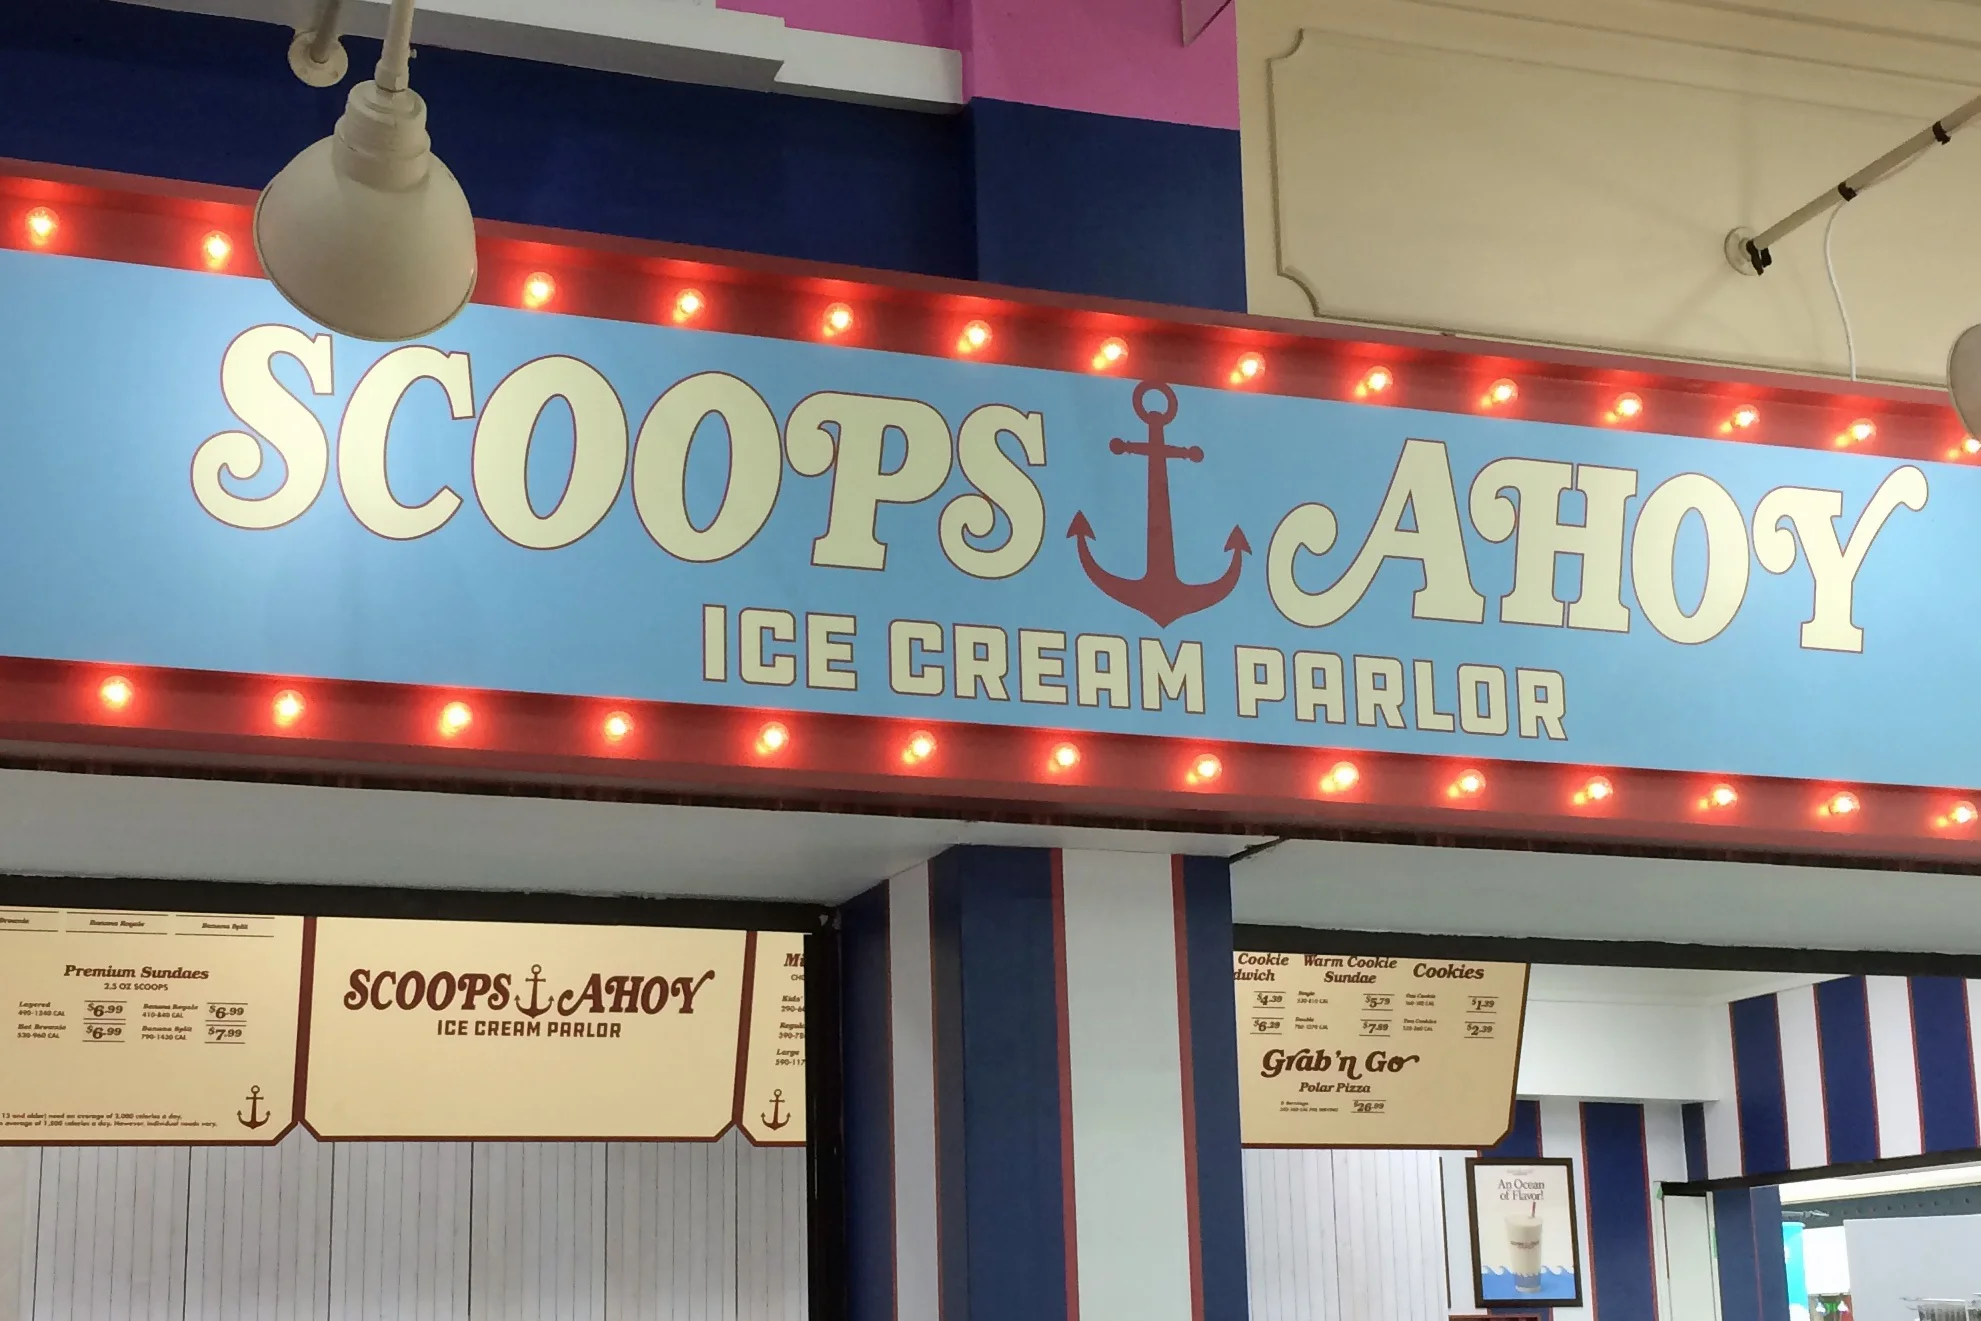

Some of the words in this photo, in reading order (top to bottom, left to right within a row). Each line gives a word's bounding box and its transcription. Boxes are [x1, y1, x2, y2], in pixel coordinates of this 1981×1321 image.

[191, 324, 1046, 580] SCOOPS
[1266, 437, 1929, 653] AHOY
[703, 604, 858, 691] ICE
[888, 618, 1207, 715] CREAM
[1235, 645, 1568, 741] PARLOR
[783, 952, 805, 967] Mi
[1237, 953, 1290, 966] Cookie
[1303, 953, 1344, 967] Warm
[1346, 955, 1398, 969] Cookie
[63, 964, 137, 979] Premium
[139, 965, 211, 981] Sundaes
[1233, 968, 1276, 981] dwich
[1323, 971, 1377, 984] Sundae
[1412, 962, 1485, 980] Cookies
[103, 982, 118, 991] 2.5
[118, 982, 133, 992] OZ
[134, 982, 170, 993] SCOOPS
[344, 968, 512, 1011] SCOOPS
[557, 969, 716, 1017] AHOY
[86, 1002, 125, 1018] $6.99
[208, 1004, 245, 1020] $6.99
[85, 1024, 123, 1040] $6.99
[207, 1026, 243, 1042] $7.99
[437, 1019, 469, 1036] ICE
[474, 1020, 541, 1037] CREAM
[547, 1021, 621, 1038] PARLOR
[775, 1048, 800, 1057] Large
[774, 1058, 807, 1066] 590-117
[1260, 1048, 1332, 1078] Grab
[1364, 1050, 1420, 1073] Go
[1298, 1081, 1335, 1093] Polar
[1335, 1082, 1371, 1094] Pizza
[1498, 1179, 1512, 1190] An
[1513, 1178, 1545, 1190] Ocean
[1499, 1190, 1510, 1201] of
[1512, 1189, 1544, 1201] Flavor!
